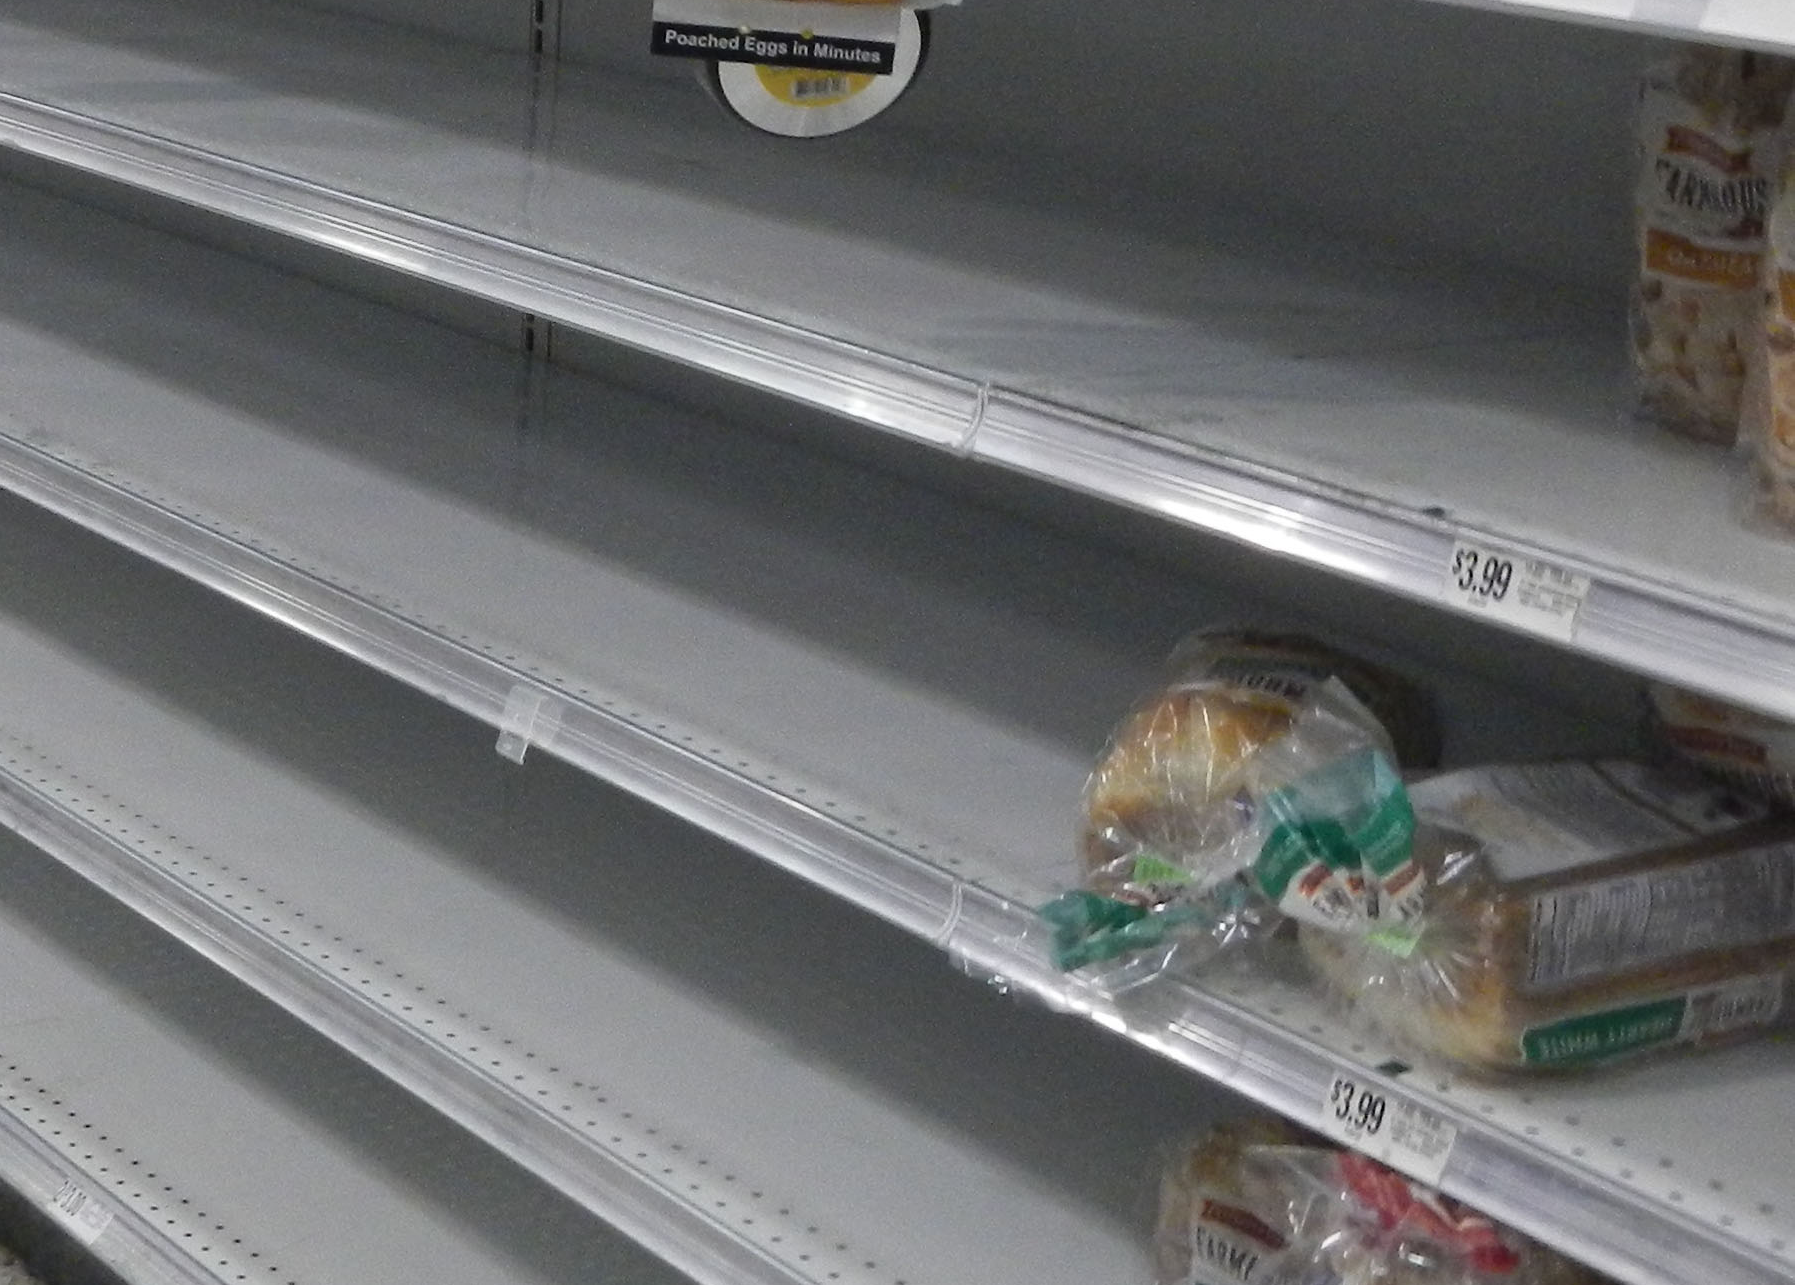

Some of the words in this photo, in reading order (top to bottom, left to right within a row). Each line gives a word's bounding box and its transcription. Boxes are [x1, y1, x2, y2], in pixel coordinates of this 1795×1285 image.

[664, 29, 740, 51] Poached
[744, 36, 789, 58] Eggs
[792, 41, 808, 56] in
[812, 43, 881, 64] Minutes
[1452, 548, 1513, 602] $3.99
[1330, 1079, 1386, 1135] $3.99
